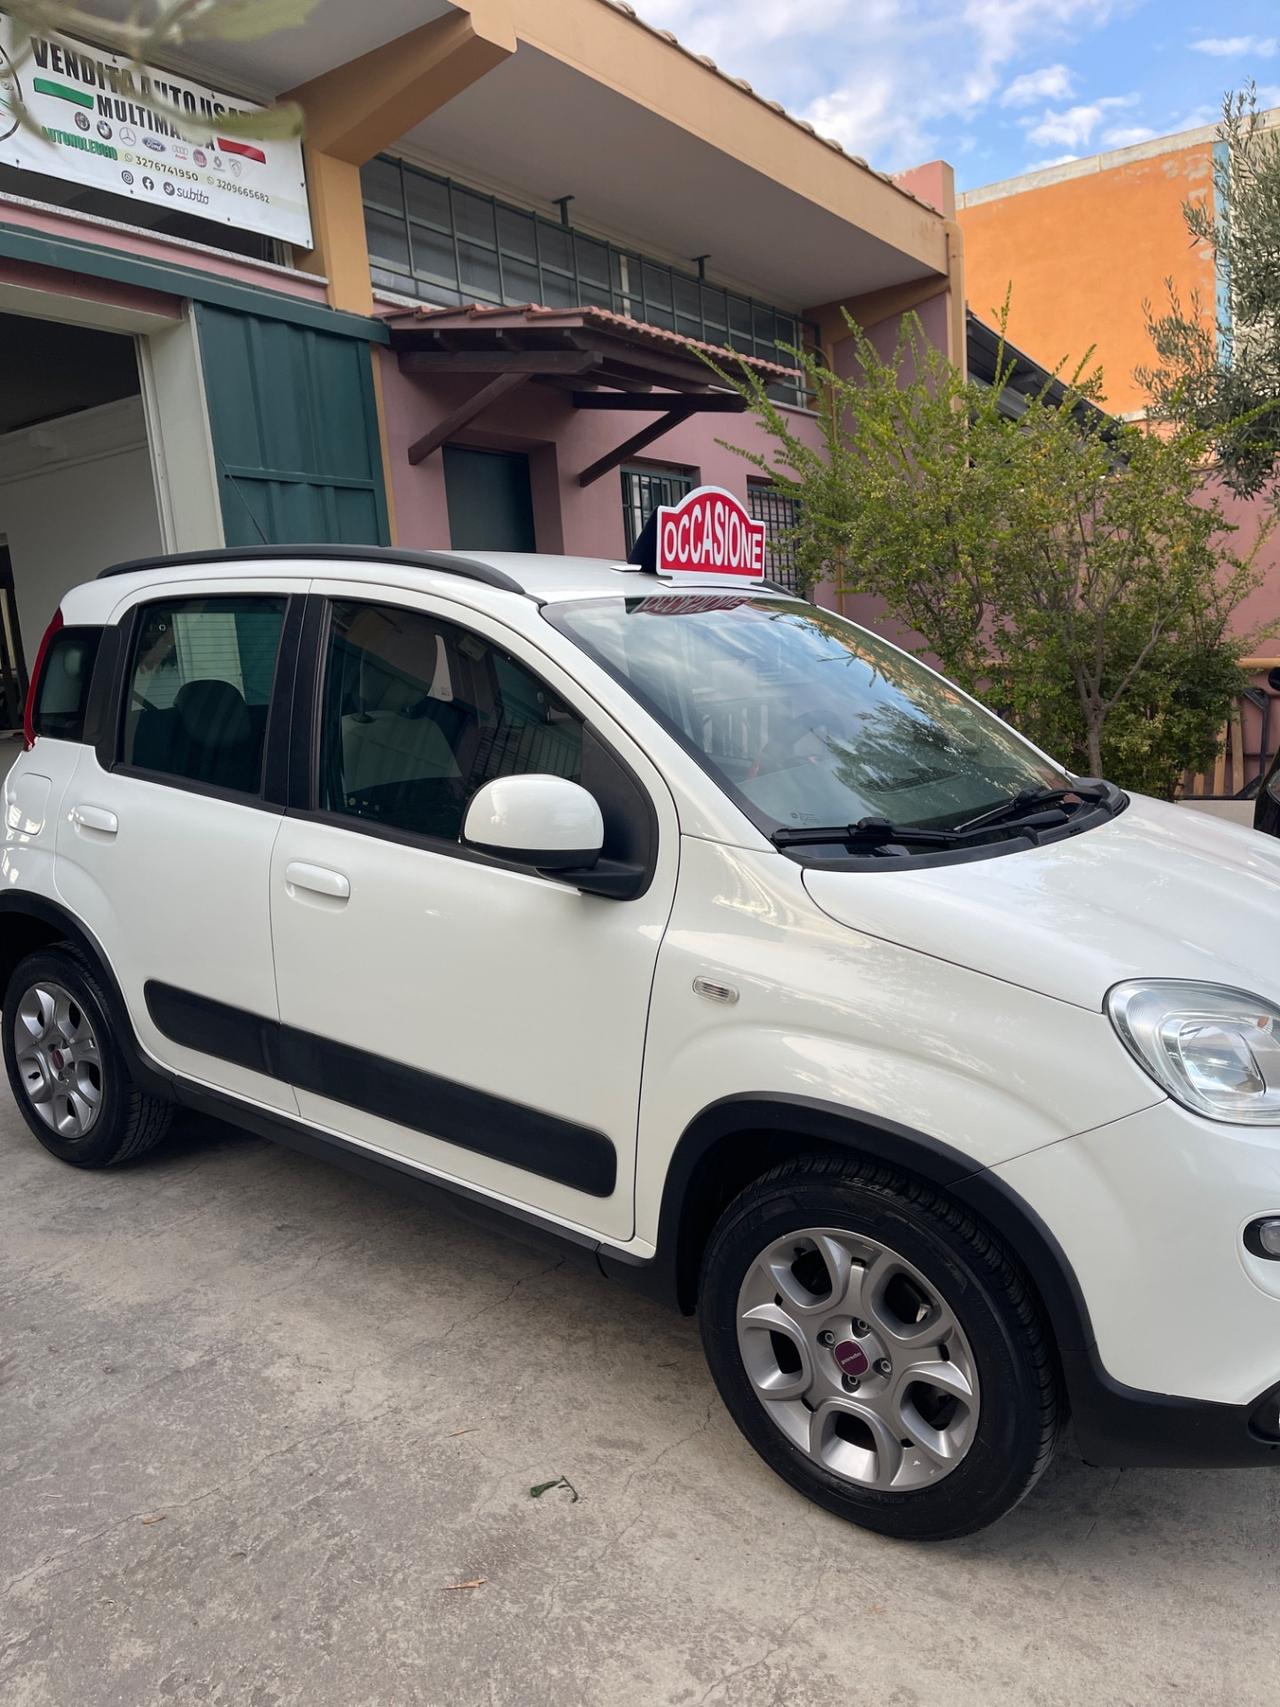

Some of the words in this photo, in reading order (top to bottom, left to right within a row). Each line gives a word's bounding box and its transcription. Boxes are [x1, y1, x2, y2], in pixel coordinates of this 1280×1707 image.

[30, 36, 136, 98] VENDITA
[135, 155, 199, 181] 3276741950
[176, 186, 210, 205] subito
[216, 178, 271, 204] 3209665682
[663, 500, 762, 570] OCCASIONE
